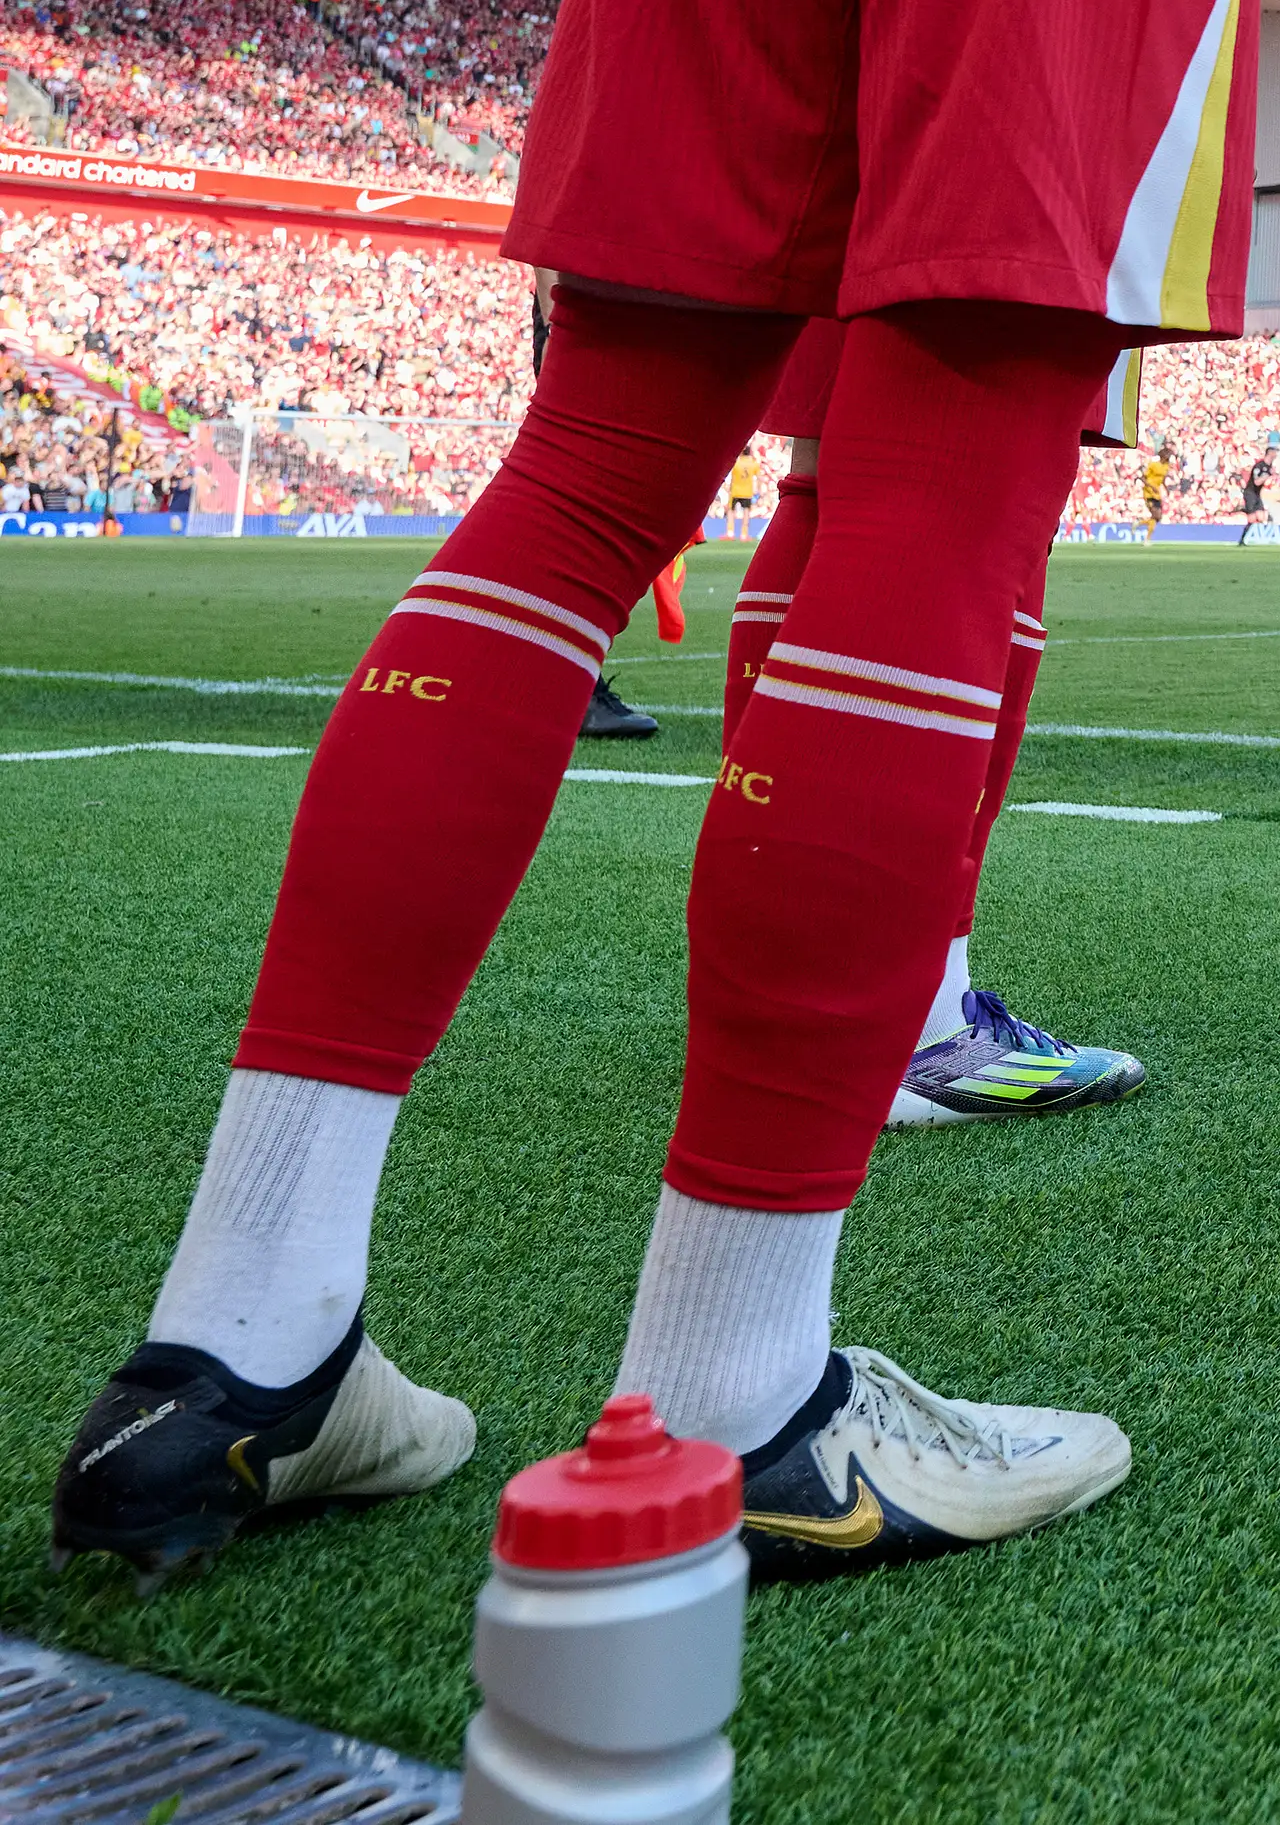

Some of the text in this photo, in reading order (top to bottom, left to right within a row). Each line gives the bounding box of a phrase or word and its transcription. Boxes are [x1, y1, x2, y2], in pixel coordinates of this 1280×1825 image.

[0, 152, 196, 191] andard chartered
[359, 667, 453, 702] LFC
